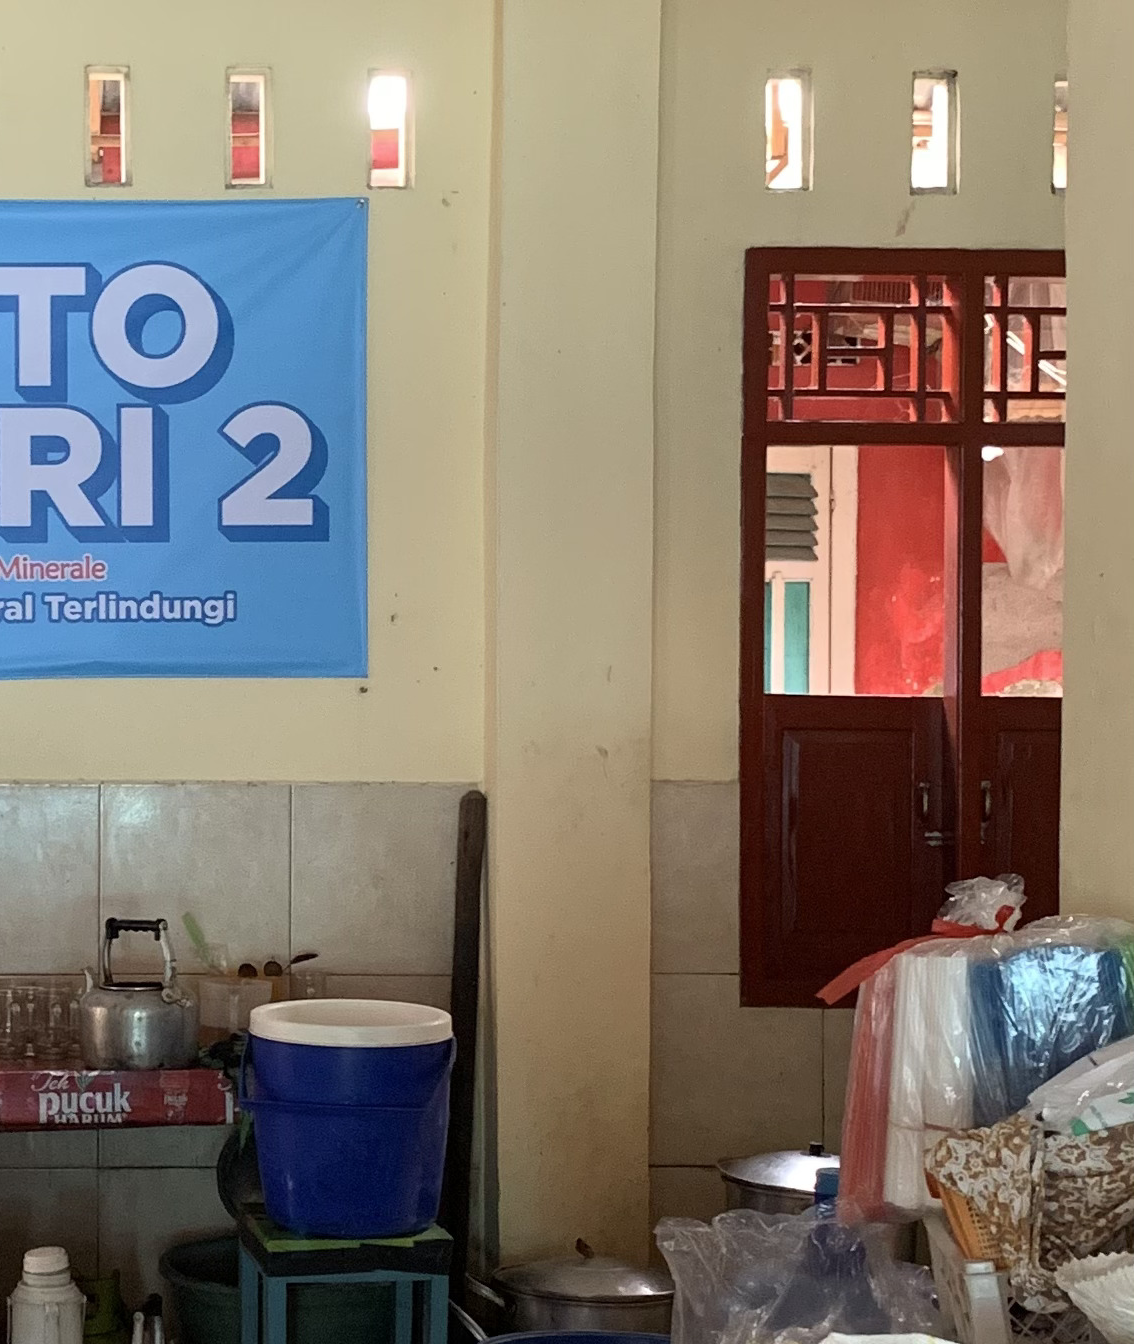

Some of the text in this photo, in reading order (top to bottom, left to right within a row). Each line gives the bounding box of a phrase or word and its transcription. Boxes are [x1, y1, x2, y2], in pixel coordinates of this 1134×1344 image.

[218, 401, 326, 538] 2
[44, 592, 236, 625] Terlindungi
[38, 1083, 132, 1124] pucuk
